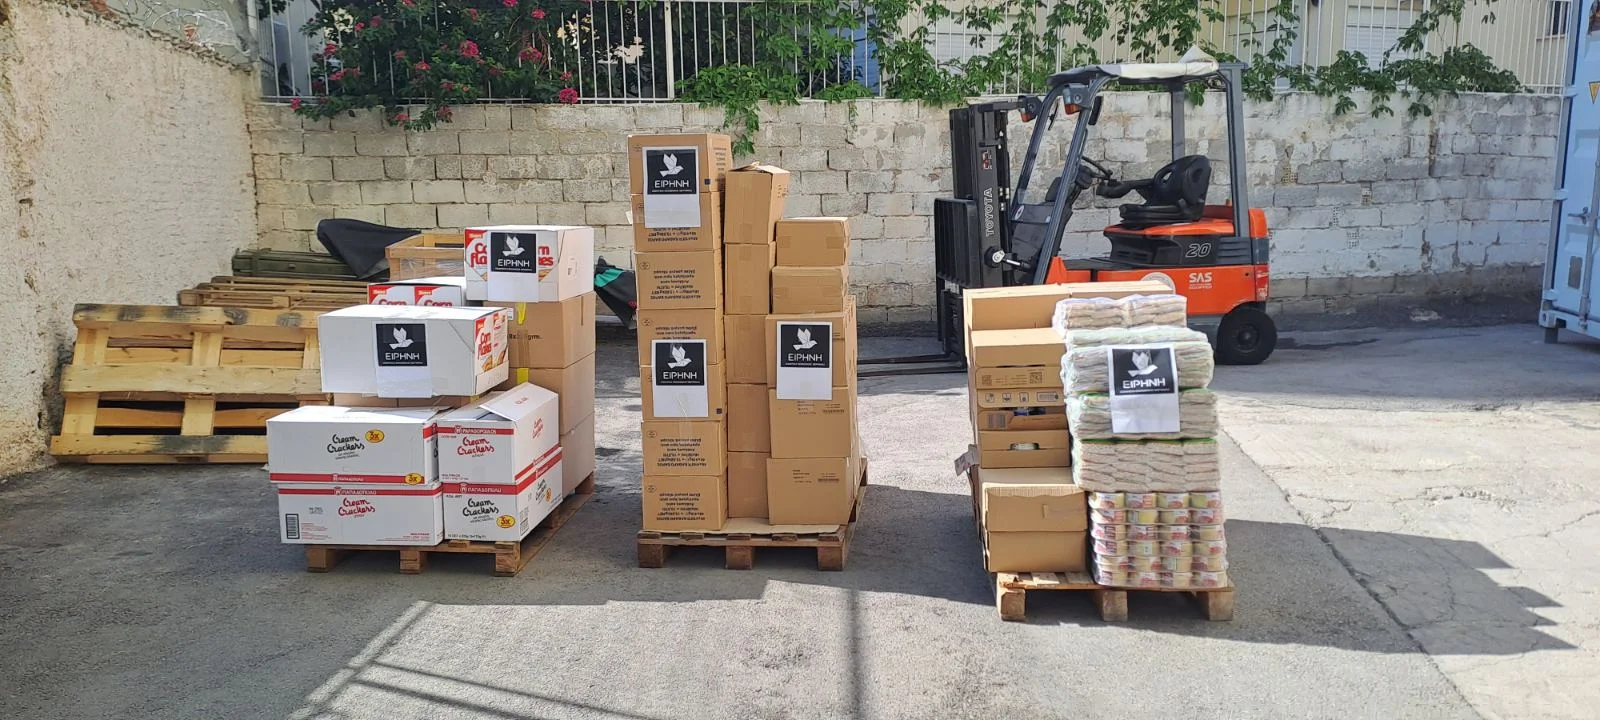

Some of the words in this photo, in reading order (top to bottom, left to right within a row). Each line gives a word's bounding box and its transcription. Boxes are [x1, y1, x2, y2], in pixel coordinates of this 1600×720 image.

[654, 179, 690, 188] ΕΙΡΗΝΗ
[983, 188, 995, 237] TOYOTA
[1185, 243, 1212, 257] 20
[497, 259, 530, 267] ΕΙΡΗΝΗ
[1188, 272, 1213, 283] SAS
[384, 352, 420, 360] ΕΙΡΗΝΗ
[787, 353, 823, 362] ΕΙΡΗΝΗ
[663, 371, 698, 380] ΕΙΡΗΝΗ
[1122, 378, 1166, 389] ΕΙΡΗΝΗ
[332, 434, 360, 444] Cream
[462, 437, 490, 446] Cream
[327, 443, 365, 453] Crackers
[457, 446, 495, 455] Crackers
[343, 498, 370, 507] Cream
[467, 498, 494, 507] Cream
[338, 506, 375, 517] Crackers
[462, 506, 499, 516] Crackers
